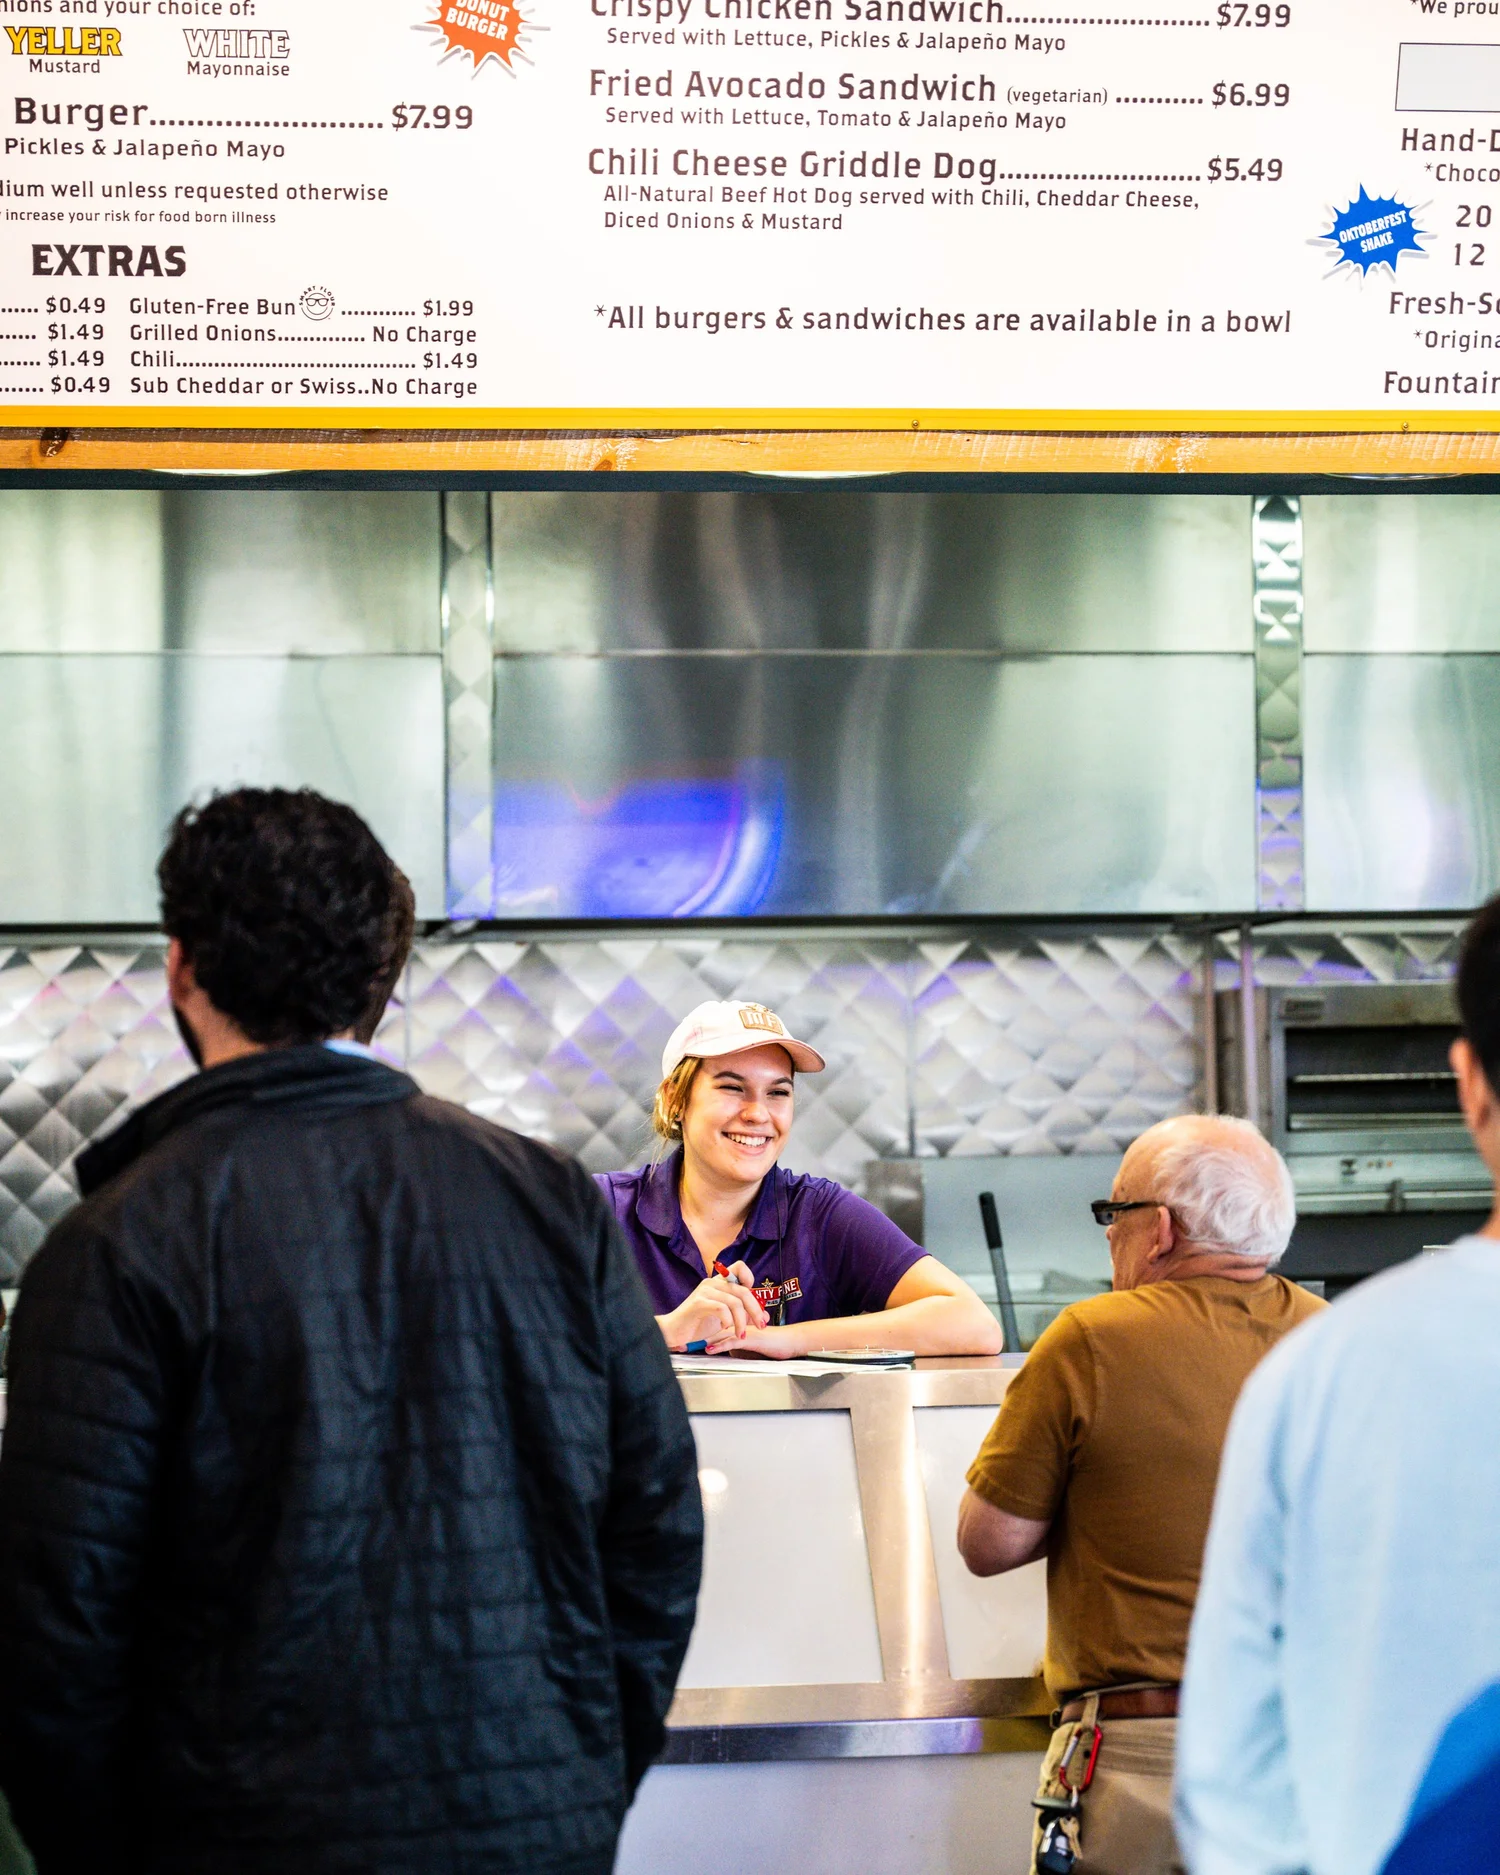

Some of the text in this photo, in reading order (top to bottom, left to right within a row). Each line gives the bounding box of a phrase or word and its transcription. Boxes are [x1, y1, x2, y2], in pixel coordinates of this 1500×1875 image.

[60, 0, 97, 13] and
[104, 1, 151, 17] your
[158, 0, 222, 15] choice
[230, 0, 254, 15] of:
[456, 0, 510, 22] DONUT
[592, 0, 1290, 29] Crispy Chicken Sandwich $7.99
[446, 7, 509, 41] BURGER
[3, 26, 123, 57] YELLER
[182, 28, 291, 59] WHITE
[608, 28, 1065, 54] Served with Lettuce, Pickles & Jalapeño Mayo
[30, 59, 100, 73] Mustard
[188, 61, 289, 78] Mayonnaise
[591, 69, 1289, 109] Fried Avocado Sandwich (vegetarian) $6.99
[15, 97, 472, 131] Burger $7.99
[607, 107, 1065, 132] Served with Lettuce, Tomato & Jalapeño Mayo
[5, 138, 284, 161] Pickles & Jalapeño Mayo
[589, 148, 1282, 185] Chili Cheese Griddle Dog $5.49
[51, 181, 93, 197] well
[102, 182, 167, 198] unless
[175, 183, 277, 202] requested
[287, 184, 388, 200] otherwise
[604, 185, 1198, 209] All-Natural Beef Hot Dog served with Chili, Cheddar Cheese,
[6, 209, 275, 223] increase your risk for food born illness
[605, 212, 841, 229] Diced Onions & Mustard
[1339, 210, 1407, 243] OKTOBERFEST
[1456, 205, 1491, 227] 20
[1360, 231, 1395, 253] SHAKE
[32, 244, 186, 277] EXTRAS
[1455, 243, 1484, 265] 12
[46, 296, 105, 315] $0.49
[130, 298, 473, 317] Gluten-Free Bun $1.99
[656, 306, 765, 334] burgers
[776, 307, 793, 329] &
[803, 307, 965, 330] sandwiches
[976, 314, 1019, 330] are
[1030, 309, 1156, 331] available
[1168, 310, 1190, 332] in
[1202, 316, 1214, 332] a
[1227, 310, 1290, 332] bowl
[48, 322, 103, 341] $1.49
[131, 324, 476, 346] Grilled Onions No Charge
[49, 349, 104, 368] $1.49
[131, 351, 477, 369] Chili $1.49
[51, 375, 110, 394] $0.49
[131, 377, 477, 398] Sub Cheddar or Swiss No Charge
[778, 1279, 797, 1298] FNE
